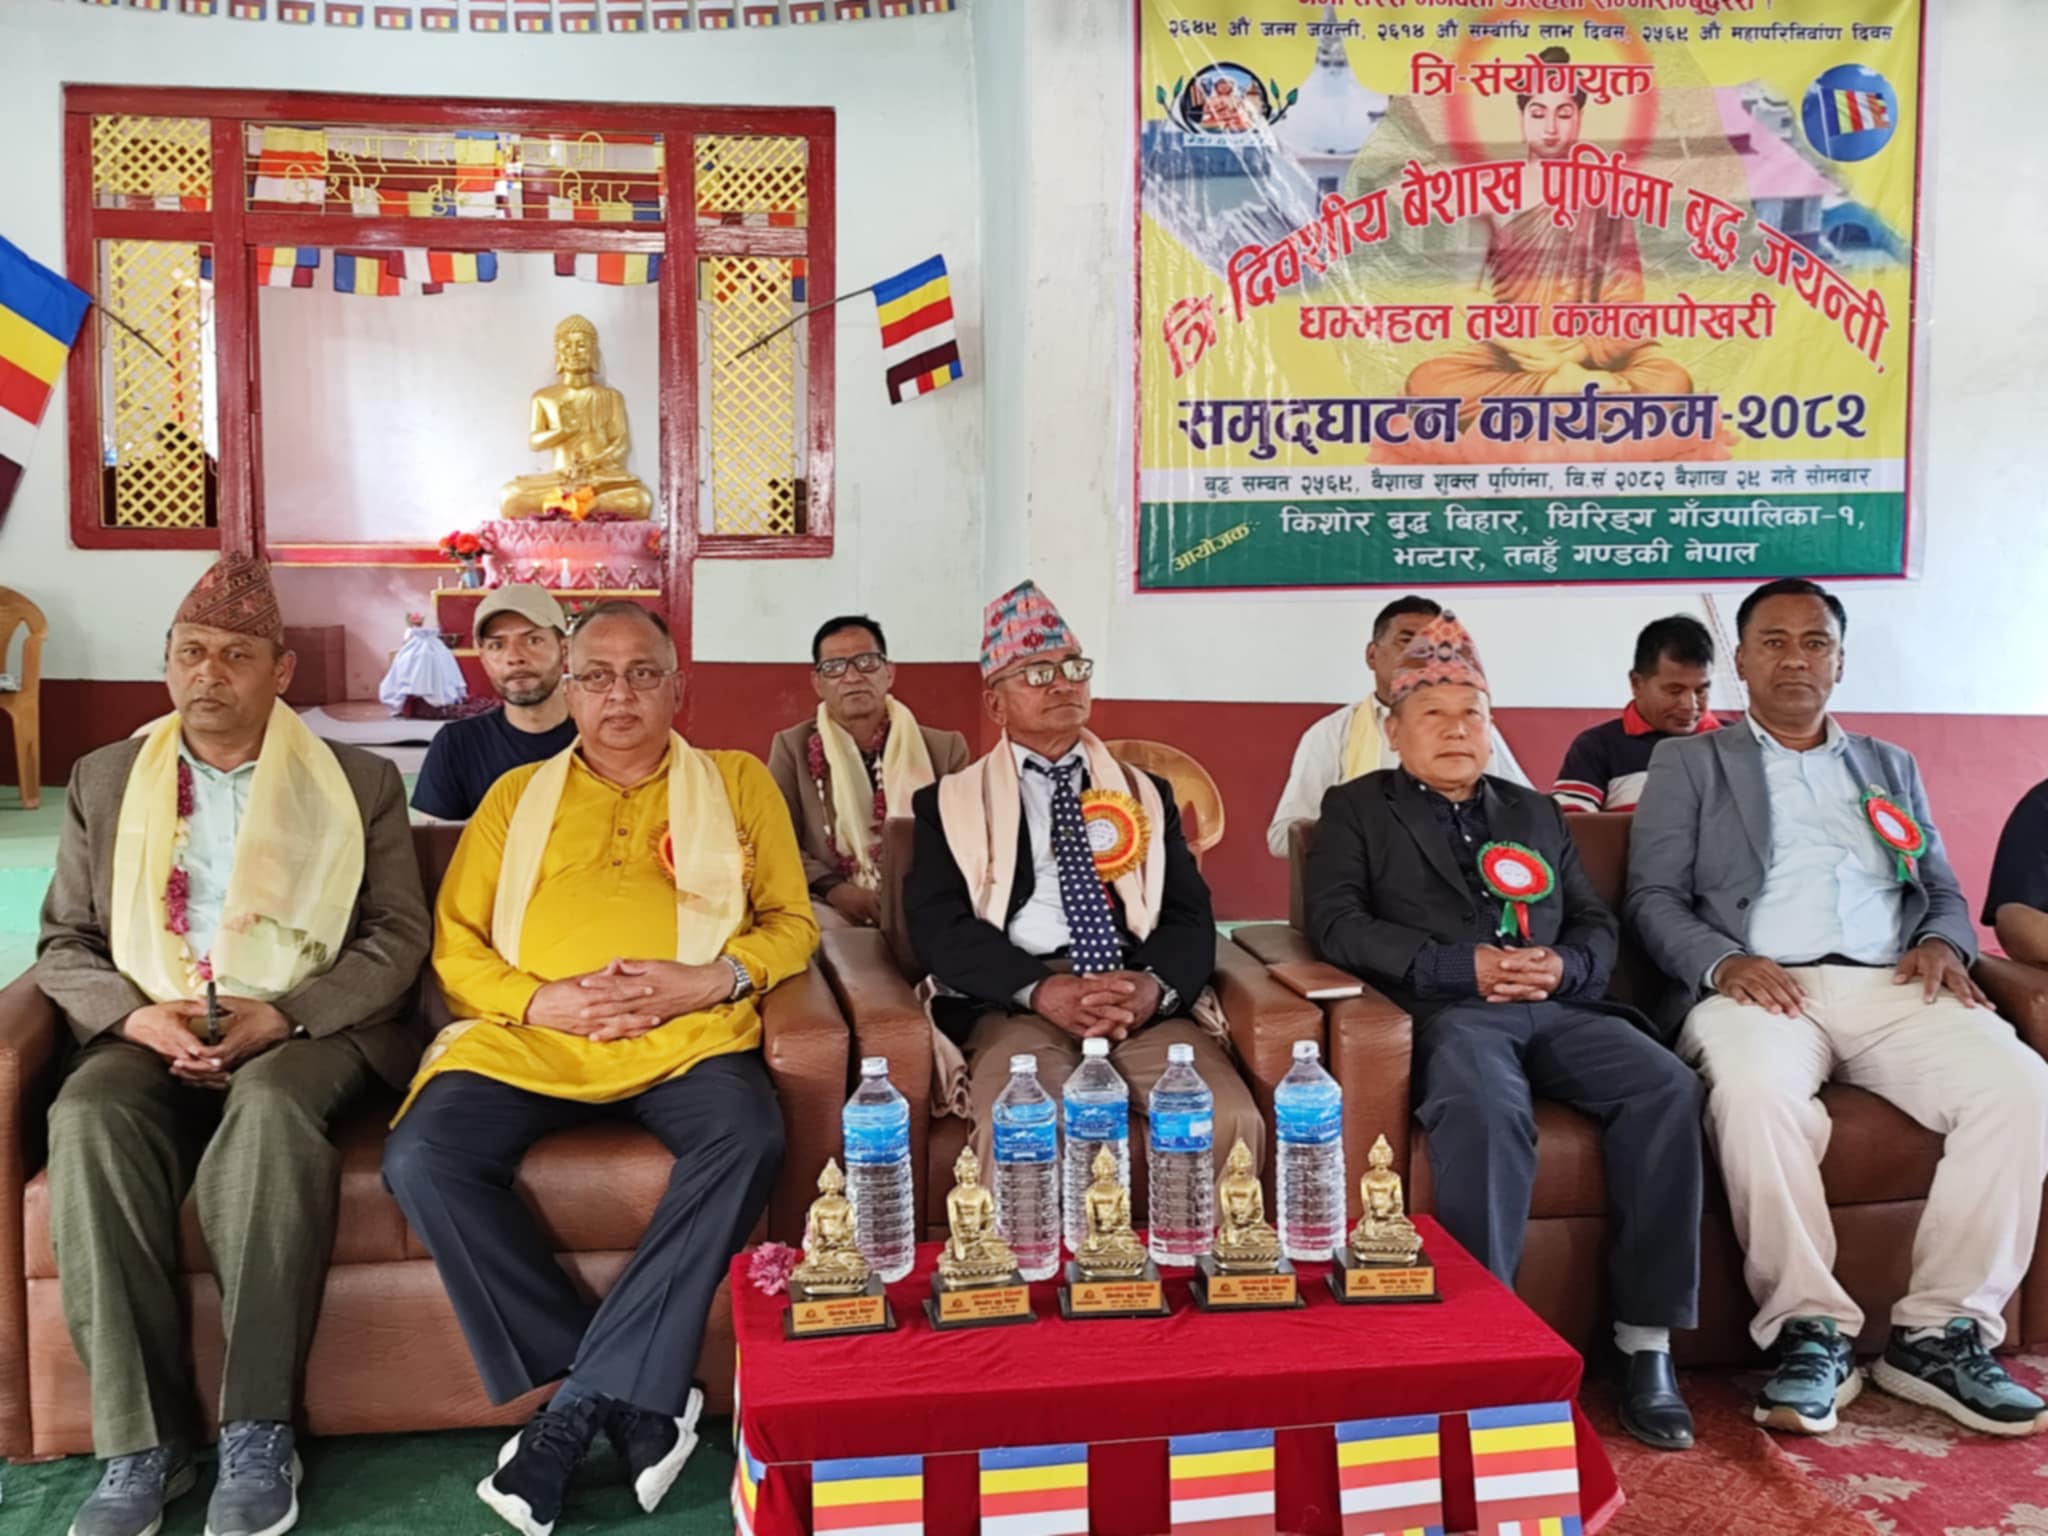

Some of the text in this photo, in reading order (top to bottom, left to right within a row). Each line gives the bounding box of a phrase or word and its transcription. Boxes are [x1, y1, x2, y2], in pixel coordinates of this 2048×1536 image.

[1168, 20, 1217, 37] २६४९
[1260, 22, 1298, 37] जन्म
[1376, 23, 1425, 41] २६१४
[1538, 23, 1574, 39] लाभ
[1642, 25, 1688, 42] २५६९
[1852, 23, 1893, 41] दिवस
[1400, 159, 1526, 226] बैशाख
[1541, 143, 1674, 230] पूर्णिमा
[1685, 188, 1745, 271] बुद्ध
[1466, 303, 1540, 341] तथा
[1552, 292, 1777, 340] कमलपोखरी
[1432, 472, 1479, 496] शुक्ल
[1614, 471, 1666, 491] २०८२
[1736, 469, 1761, 489] २९
[1770, 465, 1797, 486] गते
[1278, 505, 1377, 537] किशोर
[1387, 510, 1432, 540] बुद्ध
[1443, 503, 1529, 536] बिहार,
[1393, 536, 1761, 573] भन्टार, तनहुँ गण्डकी नेपाल
